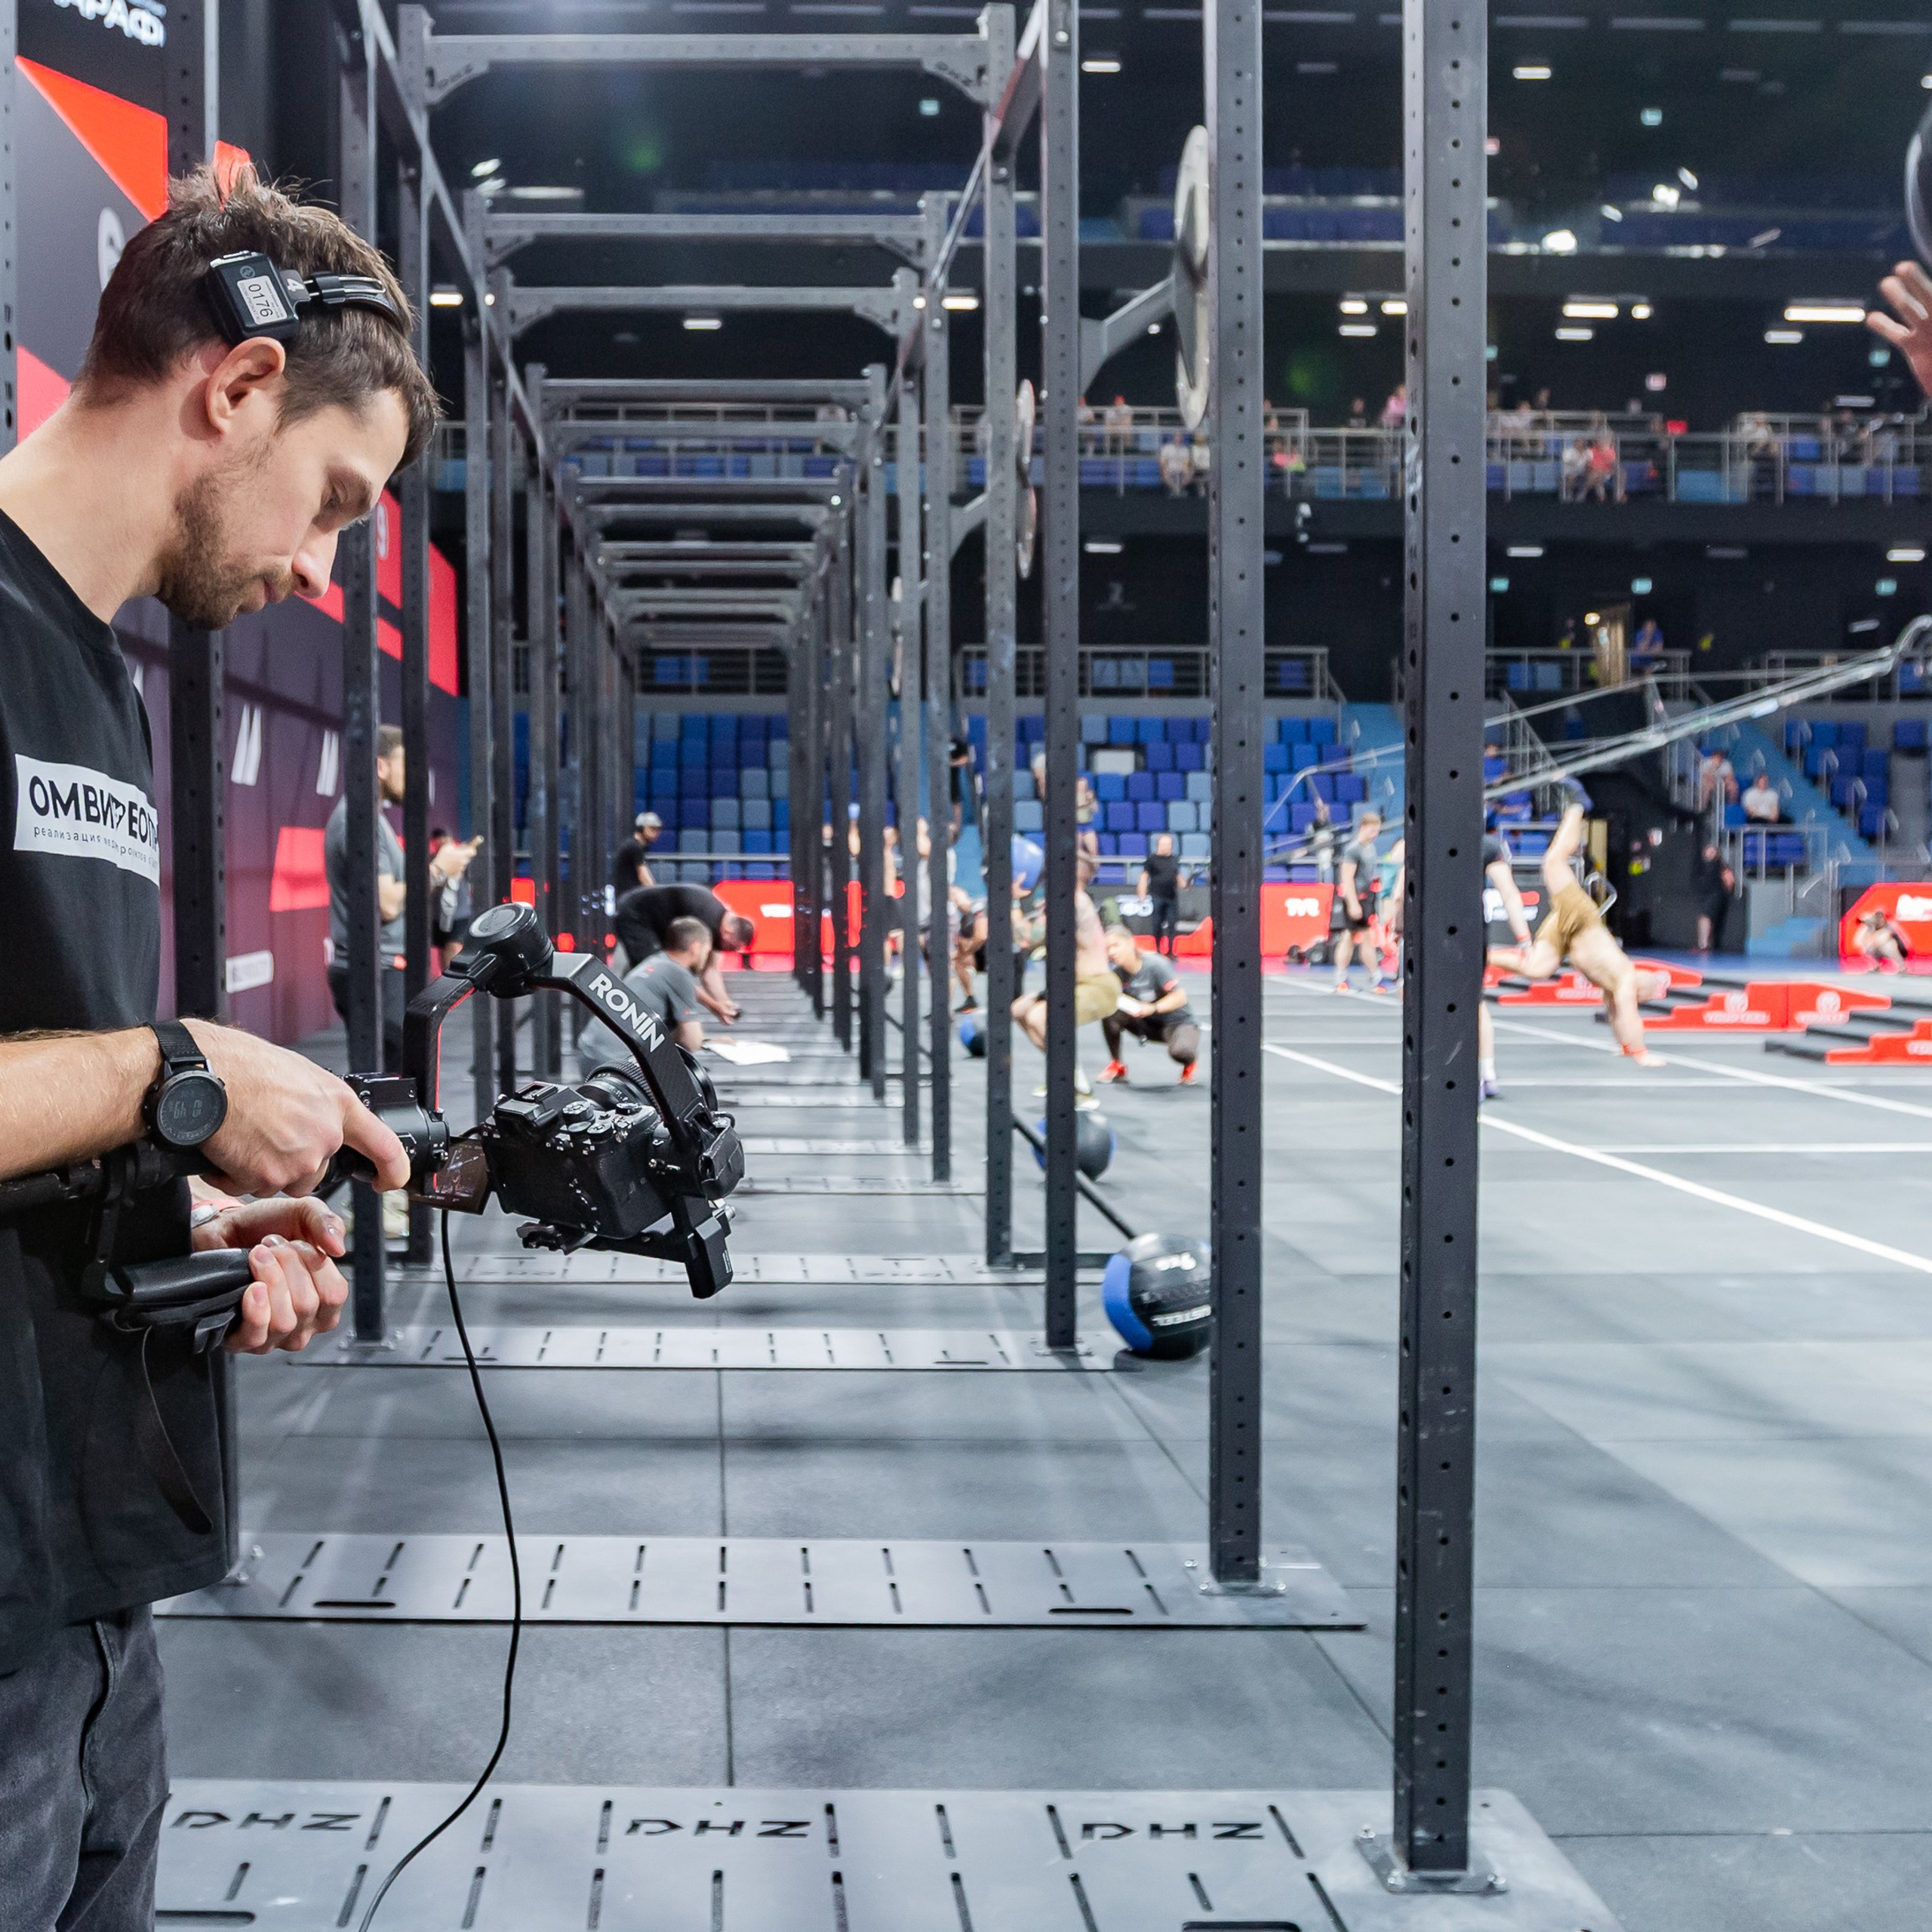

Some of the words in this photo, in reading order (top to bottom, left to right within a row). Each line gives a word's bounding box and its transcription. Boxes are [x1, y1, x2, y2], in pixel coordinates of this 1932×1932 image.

[287, 278, 305, 292] 4
[248, 284, 273, 317] 0176
[588, 973, 666, 1054] RONIN
[169, 1811, 361, 1831] DHZ
[624, 1818, 812, 1838] DHZ
[1081, 1823, 1265, 1841] DHZ
